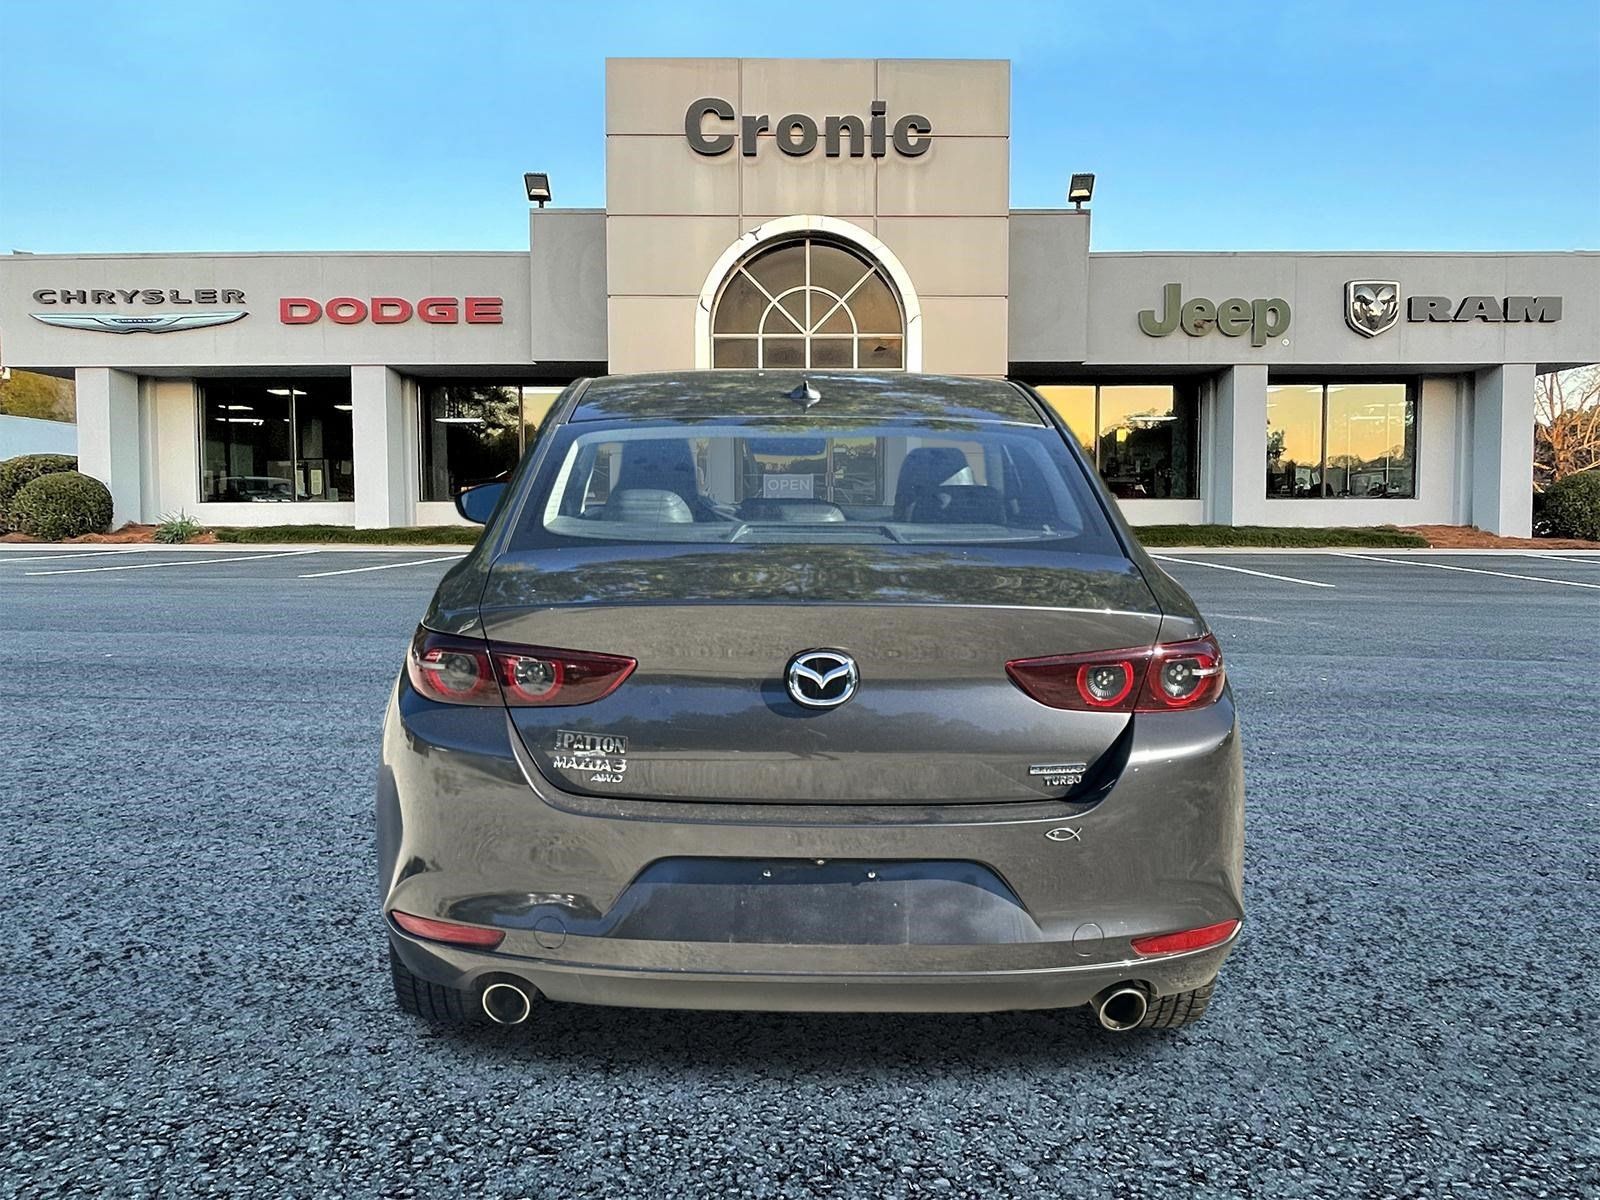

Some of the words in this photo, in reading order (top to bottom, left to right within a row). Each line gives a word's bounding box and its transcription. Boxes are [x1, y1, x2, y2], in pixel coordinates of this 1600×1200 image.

[685, 97, 931, 157] Cronic
[32, 288, 247, 304] CHRYSLER
[279, 297, 503, 324] DODGE
[1138, 283, 1291, 347] Jeep
[1408, 296, 1563, 322] RAM
[767, 479, 810, 491] OPEN
[563, 733, 626, 754] PATTON
[590, 773, 623, 783] AWD
[1043, 775, 1082, 786] TURBO
